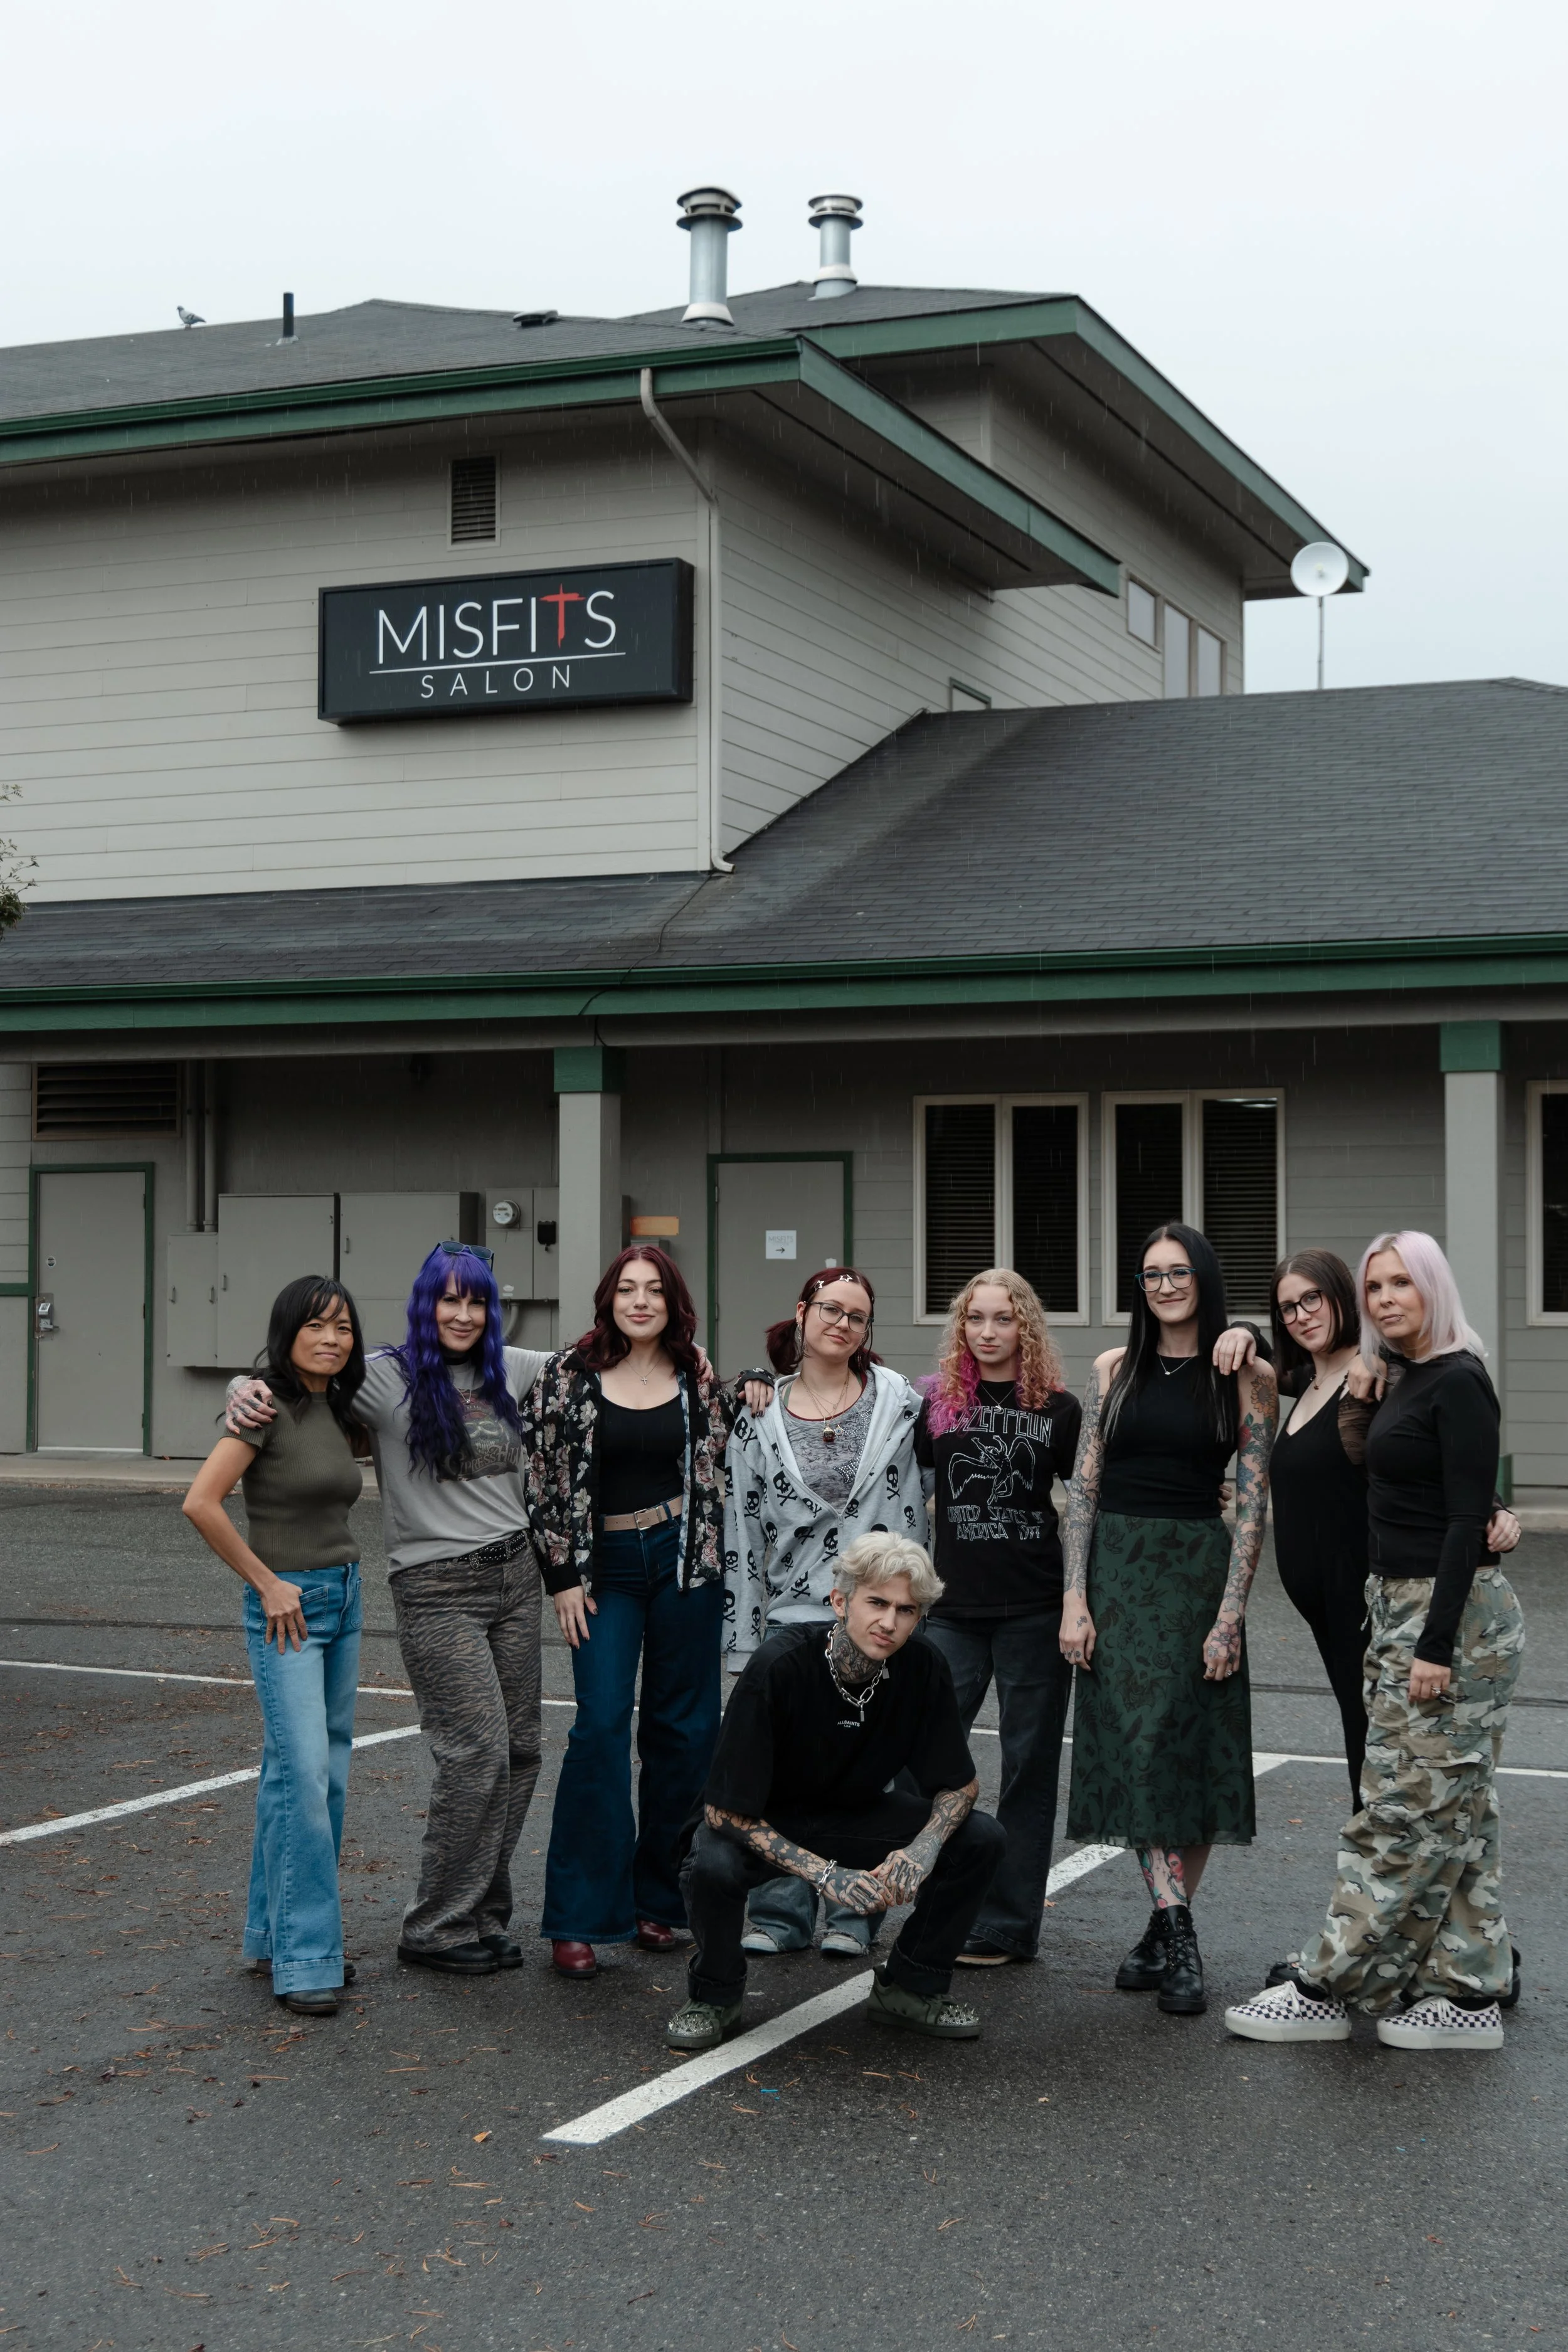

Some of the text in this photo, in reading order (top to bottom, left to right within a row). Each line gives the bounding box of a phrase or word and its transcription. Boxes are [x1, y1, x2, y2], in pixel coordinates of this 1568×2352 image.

[378, 583, 617, 664] MISFITS
[421, 665, 570, 698] SALON
[947, 1505, 981, 1523] UNITED
[987, 1506, 1029, 1525] STATES
[956, 1522, 1040, 1541] AMERICA 1977
